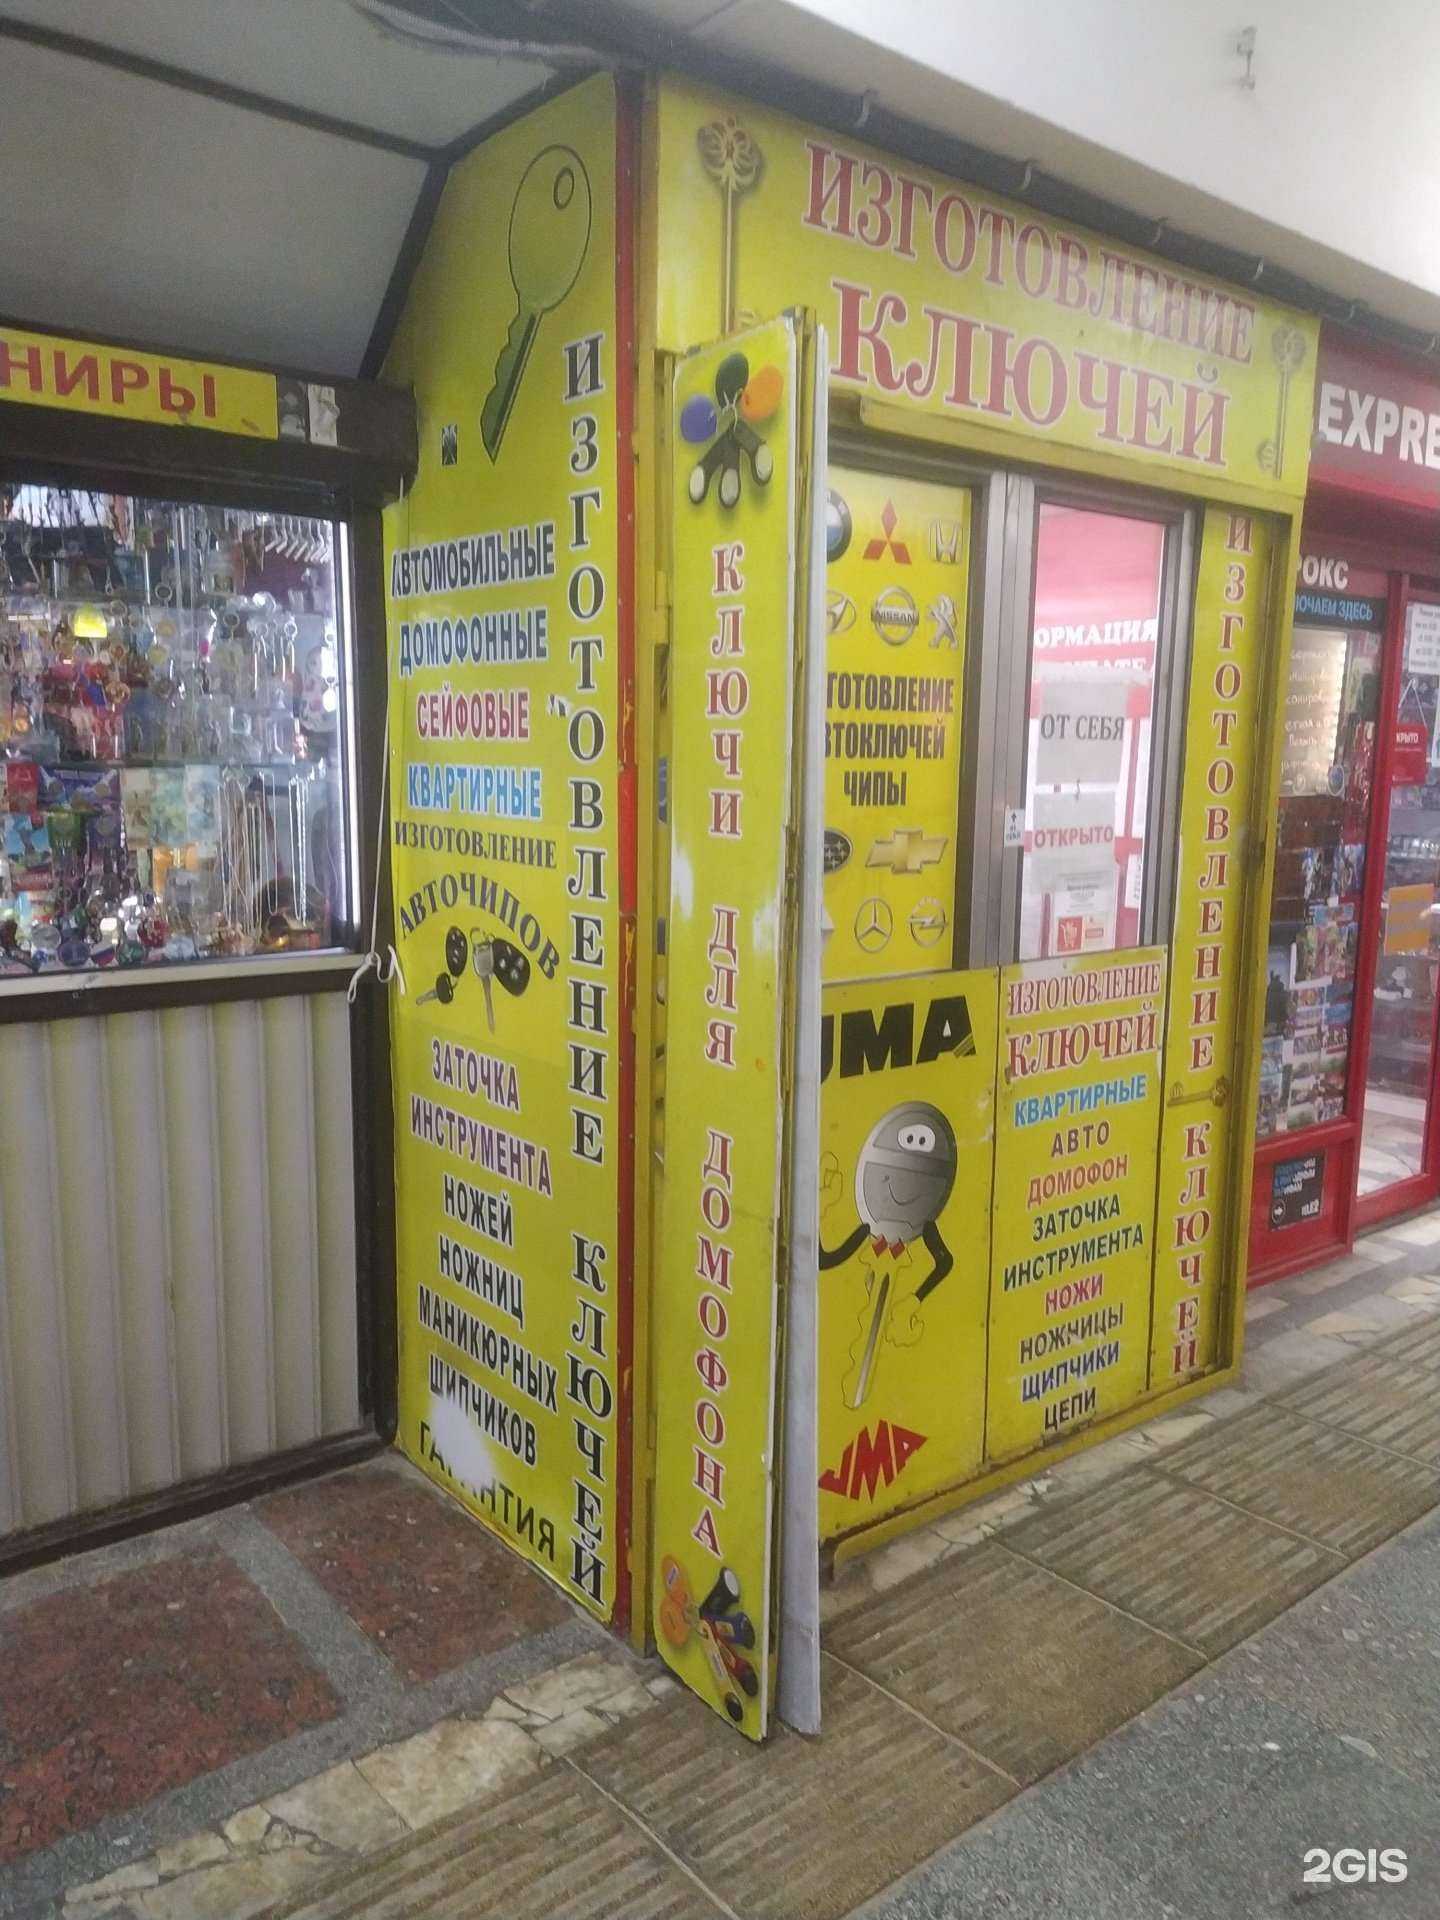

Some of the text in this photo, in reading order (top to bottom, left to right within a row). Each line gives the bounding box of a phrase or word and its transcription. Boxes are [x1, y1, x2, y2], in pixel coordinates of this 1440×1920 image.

[804, 142, 1256, 365] ИЗГОТОВЛЕНИЕ
[0, 341, 217, 419] НИРЫ
[831, 279, 1231, 466] КЛЮЧЕЙ
[1318, 381, 1440, 470] EXPRE
[391, 522, 555, 598] АВТОМОБИЛЬНЫЕ
[400, 608, 548, 676] ДОМОФОННЫЕ
[1034, 618, 1158, 648] ОРМАЦИЯ
[1338, 599, 1373, 622] ЗДЕСЬ
[416, 684, 530, 740] СЕЙФОВЫЕ
[826, 671, 955, 713] ГОТОВЛЕНИЕ
[1040, 713, 1125, 741] ОТ СЕБЯ
[408, 764, 542, 818] КВАРТИРНЫЕ
[843, 770, 908, 807] ЧИПЫ
[395, 820, 557, 870] ИЗГОТОВЛЕНИЕ
[1034, 825, 1114, 848] ОТКРЫТО
[399, 871, 561, 981] АВТОЧИПОВ
[1172, 514, 1254, 1376] ИЗГОТОВЛЕНИЕ КЛЮЧЕЙ
[563, 333, 613, 1606] ИЗГОТОВЛЕНИЕ КЛЮЧЕЙ
[1008, 963, 1161, 1017] ИЗГОТОВЛЕНИЕ
[692, 543, 749, 1558] КЛЮЧИ ДЛЯ ДОМОФОНА
[1008, 1001, 1158, 1079] КЛЮЧЕЙ
[432, 1038, 521, 1112] ЗАТОЧКА
[1014, 1074, 1147, 1128] КВАРТИРНЫЕ
[410, 1094, 552, 1197] ИНСТРУМЕНТА
[1050, 1120, 1111, 1158] АВТО
[443, 1173, 514, 1248] НОЖЕЙ
[1026, 1154, 1129, 1210] ДОМОФОН
[1032, 1193, 1121, 1242] ЗАТОЧКА
[439, 1234, 524, 1329] НОЖНИЦ
[1003, 1223, 1145, 1292] ИНСТРУМЕНТА
[1044, 1273, 1104, 1316] НОЖИ
[418, 1285, 558, 1413] МАНИКЮРНЫХ
[1021, 1340, 1120, 1403] ЩИПЧИКИ
[1043, 1386, 1097, 1432] ЦЕПИ
[818, 1419, 928, 1504] JMA
